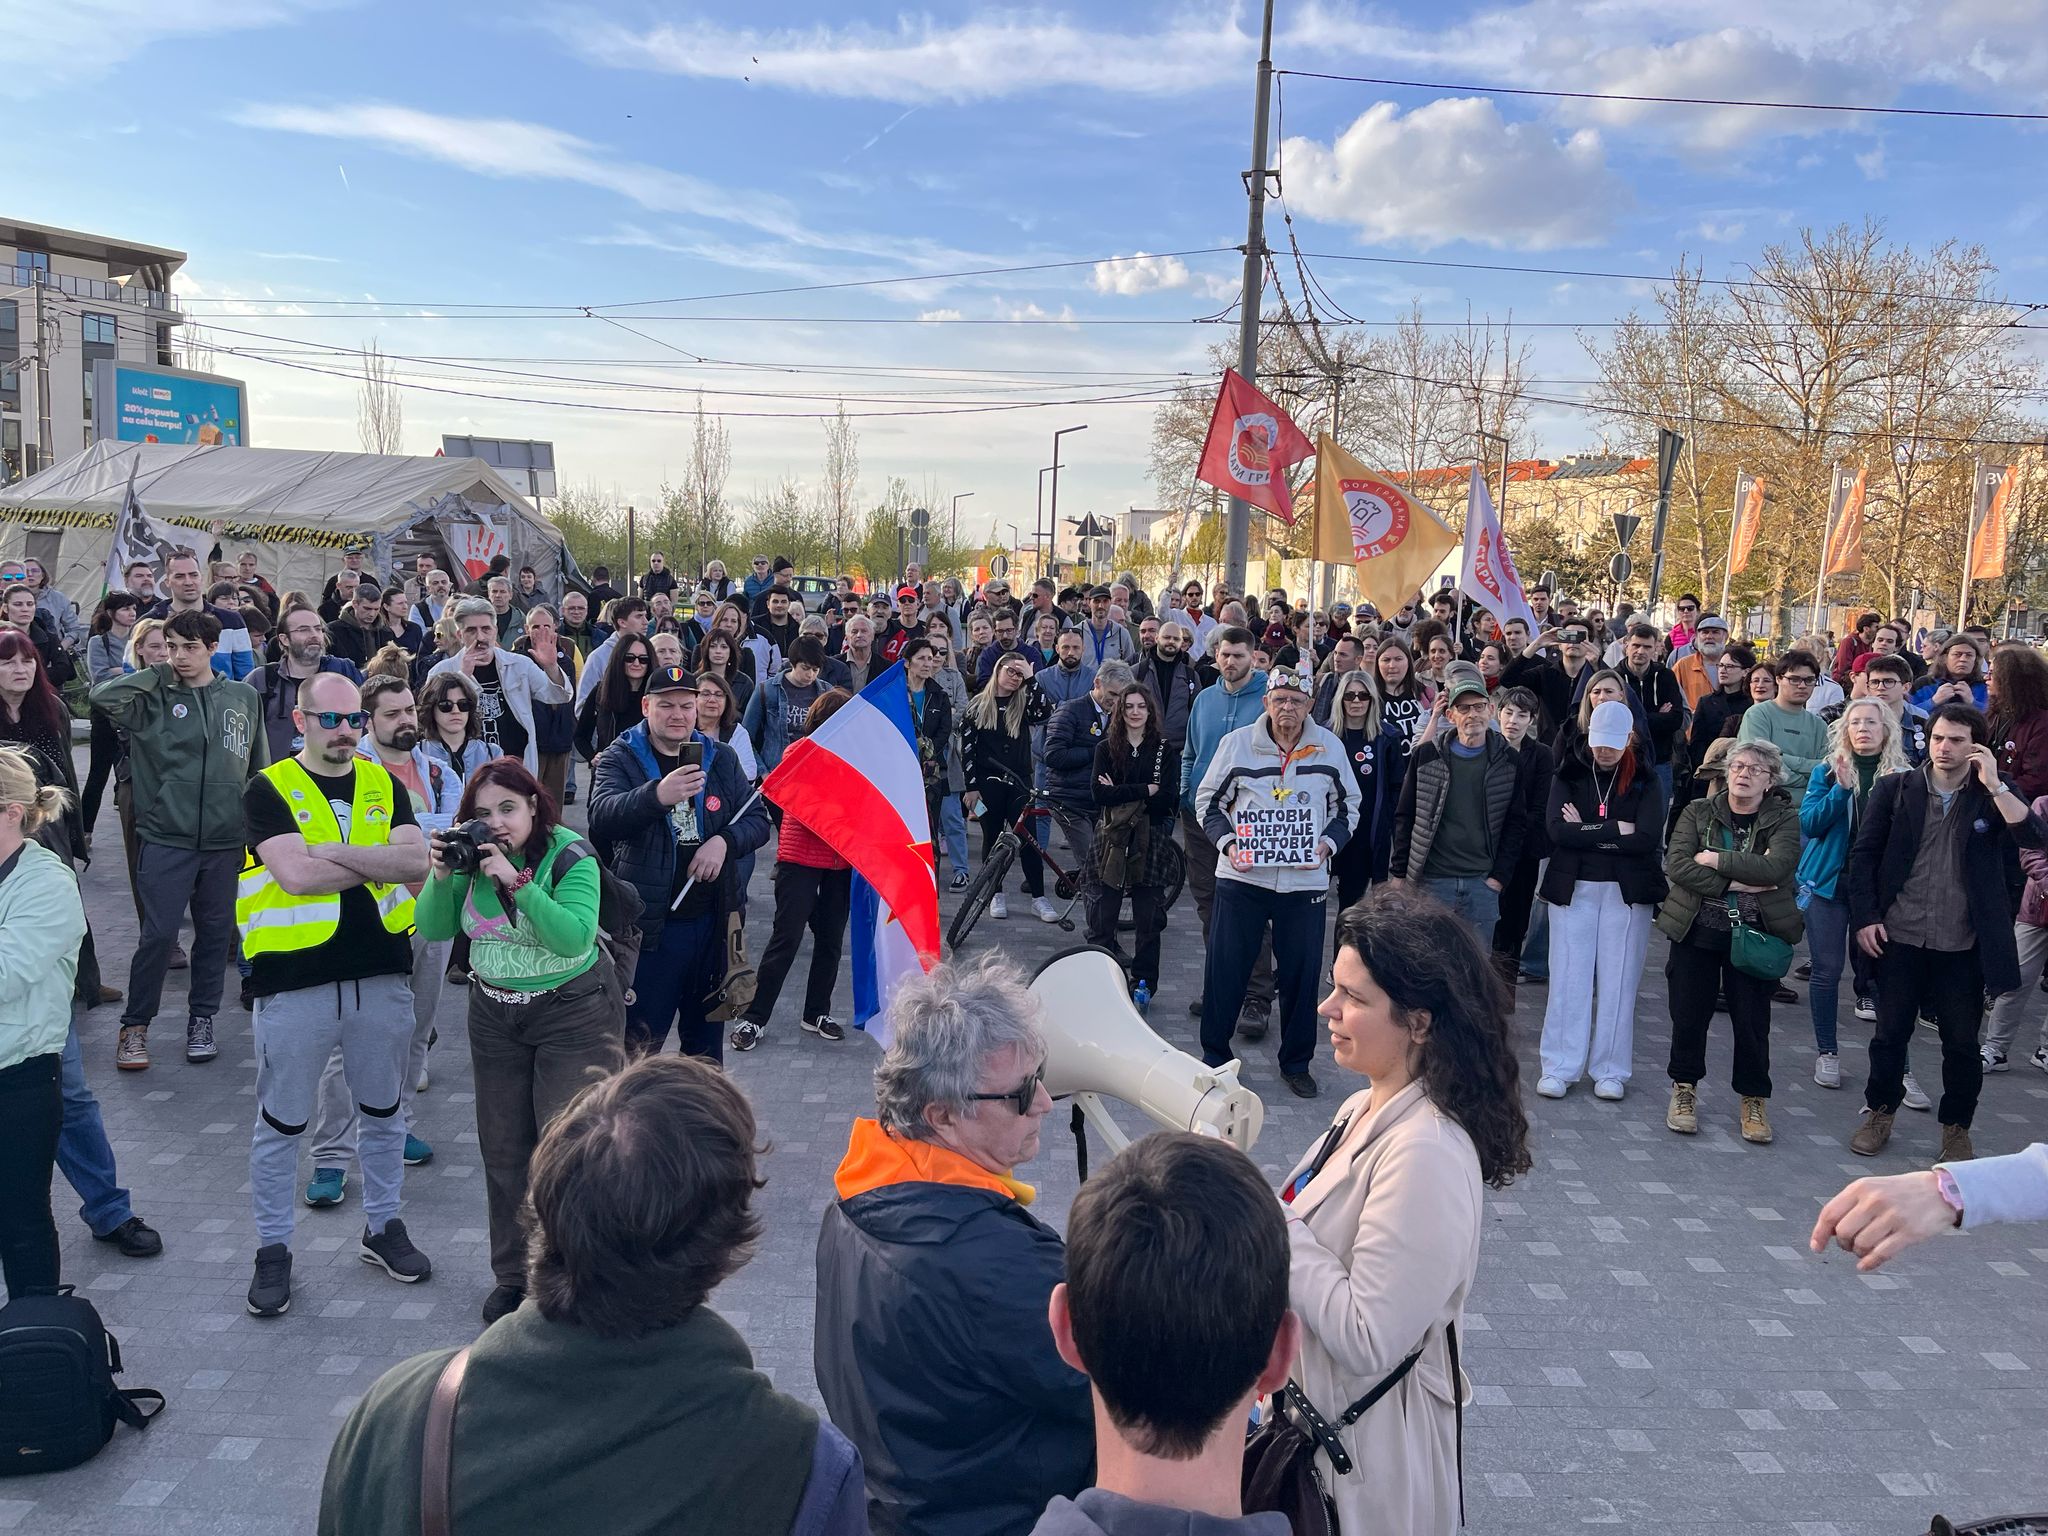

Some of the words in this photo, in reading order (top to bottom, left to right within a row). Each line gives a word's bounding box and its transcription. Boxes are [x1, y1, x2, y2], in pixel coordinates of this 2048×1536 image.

[124, 404, 143, 412] 20%
[144, 408, 180, 419] popusta
[122, 416, 134, 424] na
[136, 417, 153, 426] celu
[155, 418, 182, 430] korpu!
[1230, 443, 1245, 480] СТАРИ
[1476, 545, 1495, 588] СТАРИ
[1237, 809, 1311, 824] МОСТОВИ
[1239, 837, 1313, 850] МОСТОВИ
